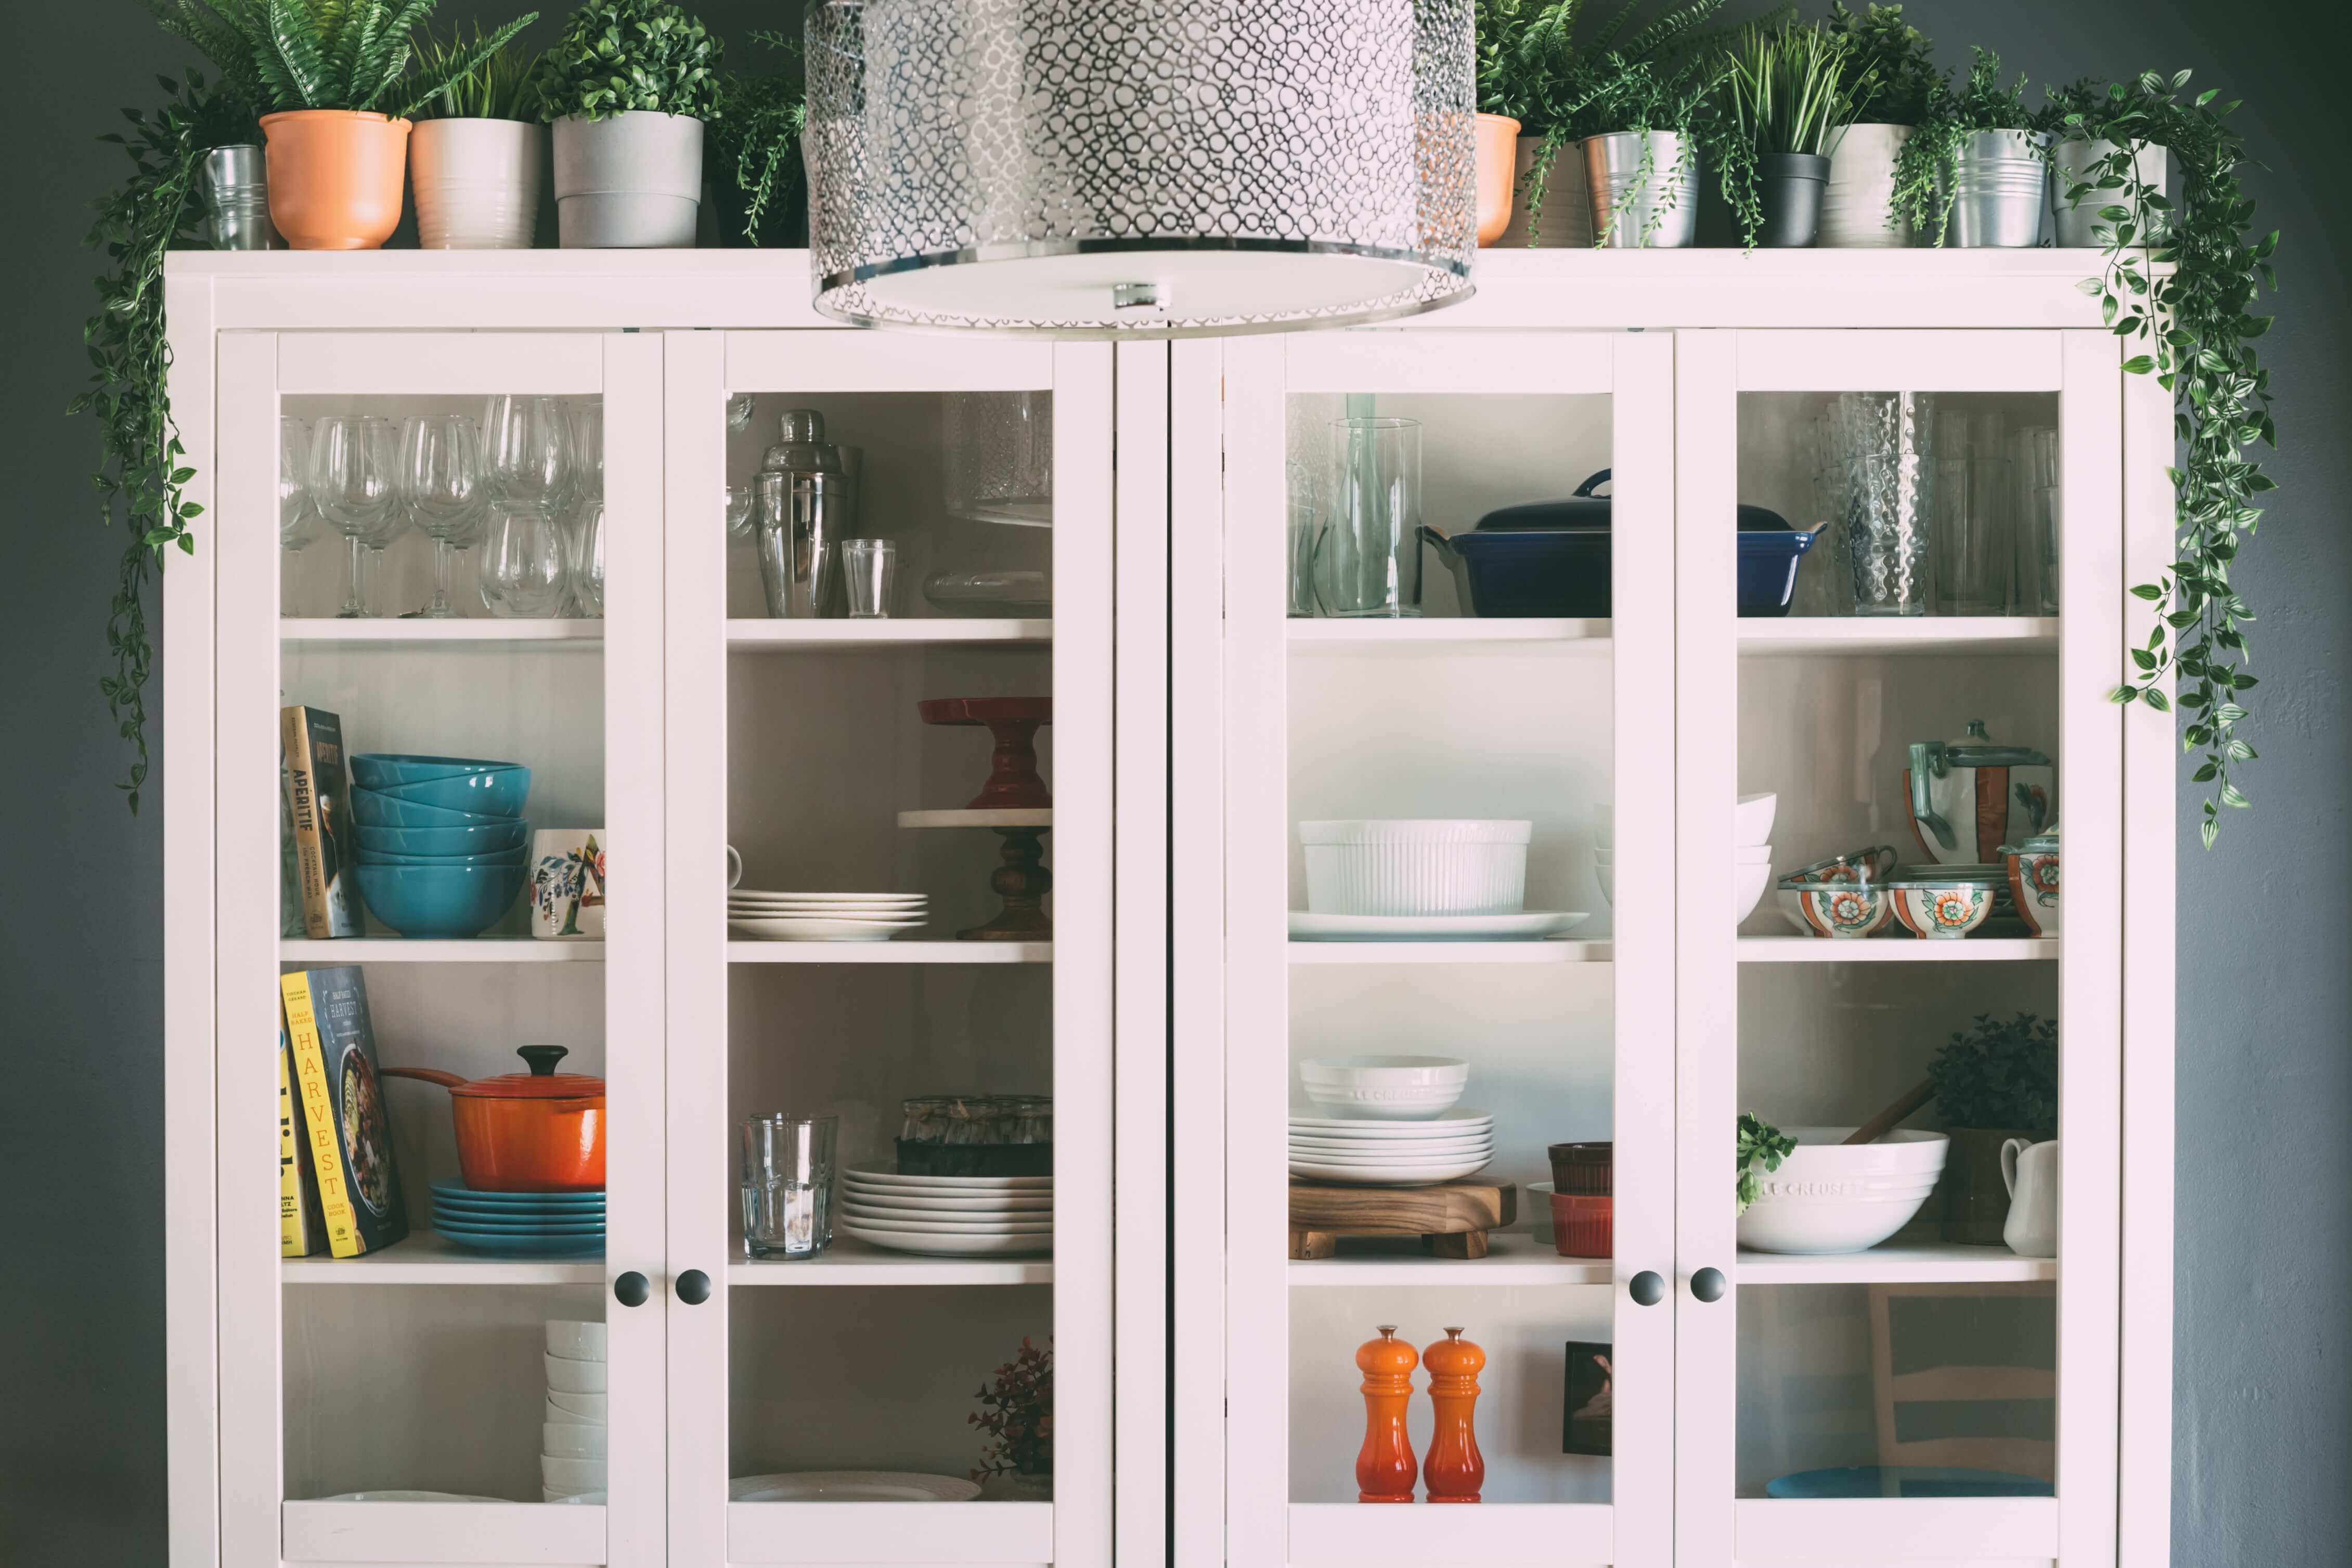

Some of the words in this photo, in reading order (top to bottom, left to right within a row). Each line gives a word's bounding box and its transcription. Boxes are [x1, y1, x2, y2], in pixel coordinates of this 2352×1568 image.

[309, 846, 318, 875] COCKTAIL
[330, 1001, 357, 1018] HARVEST
[291, 1017, 312, 1025] BAKED
[298, 1032, 338, 1195] HARVEST
[1763, 1182, 1778, 1195] LE
[327, 1202, 345, 1210] COOK
[329, 1209, 346, 1217] BOOK
